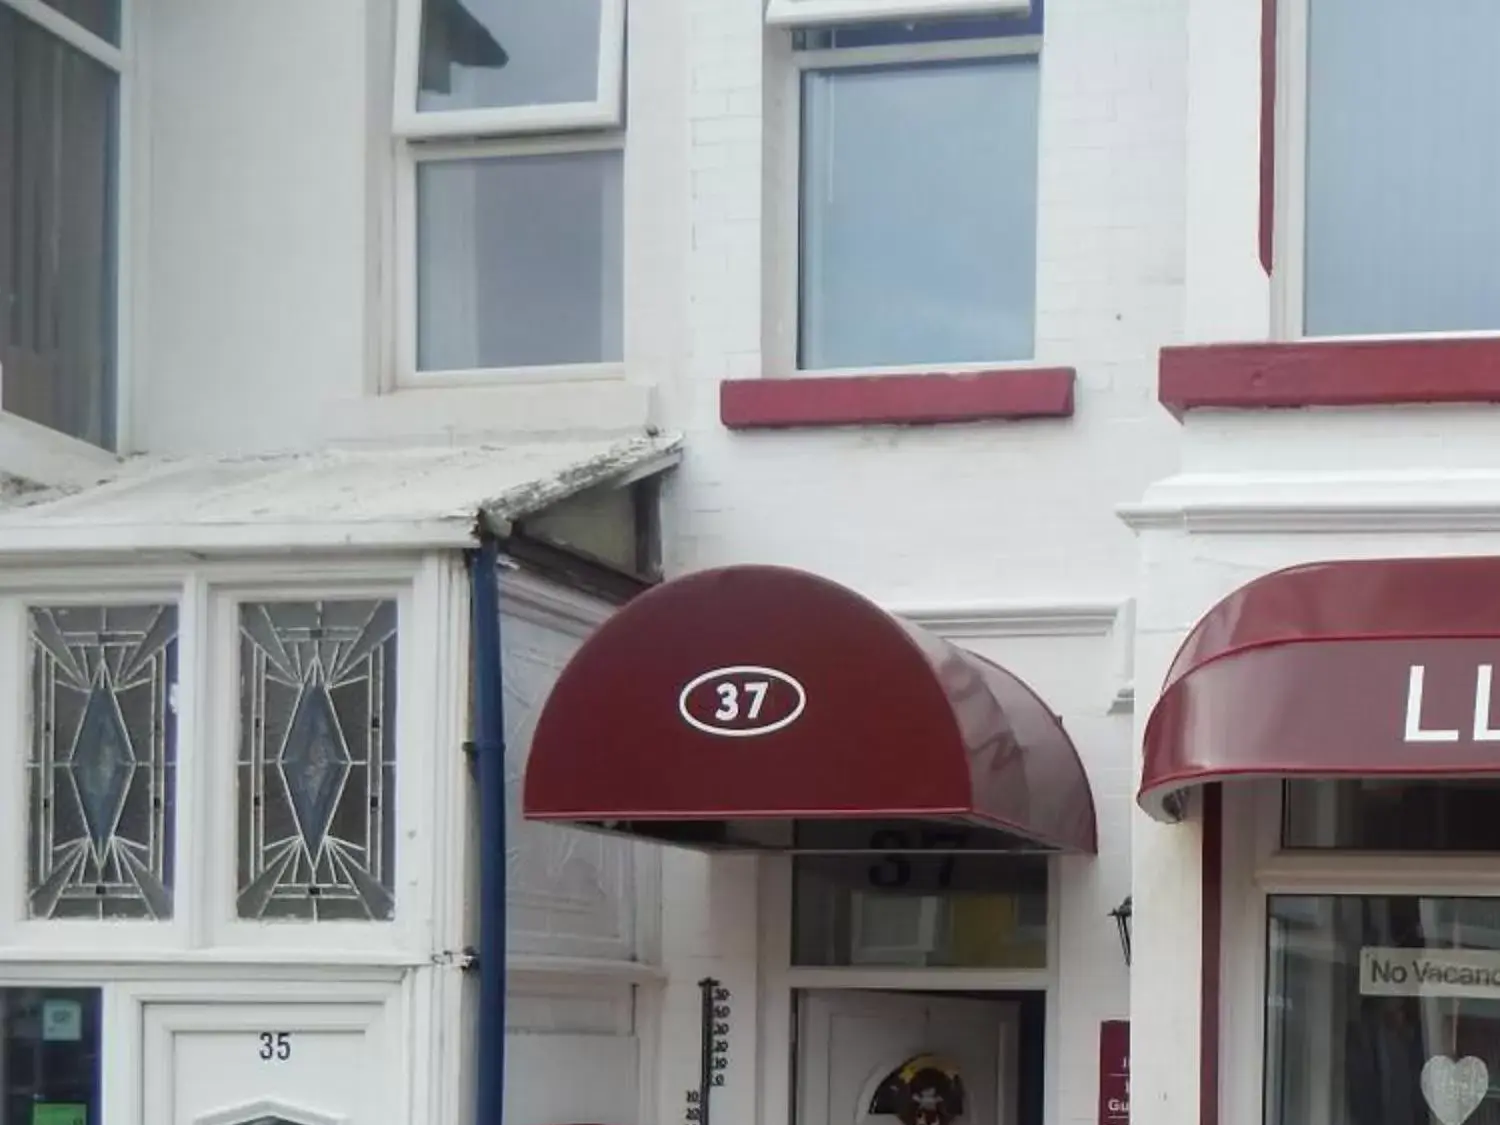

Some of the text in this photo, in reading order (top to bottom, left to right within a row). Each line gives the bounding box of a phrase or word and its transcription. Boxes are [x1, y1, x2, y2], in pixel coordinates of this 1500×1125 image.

[714, 681, 769, 721] 37
[1371, 960, 1408, 984] No
[259, 1032, 291, 1061] 35
